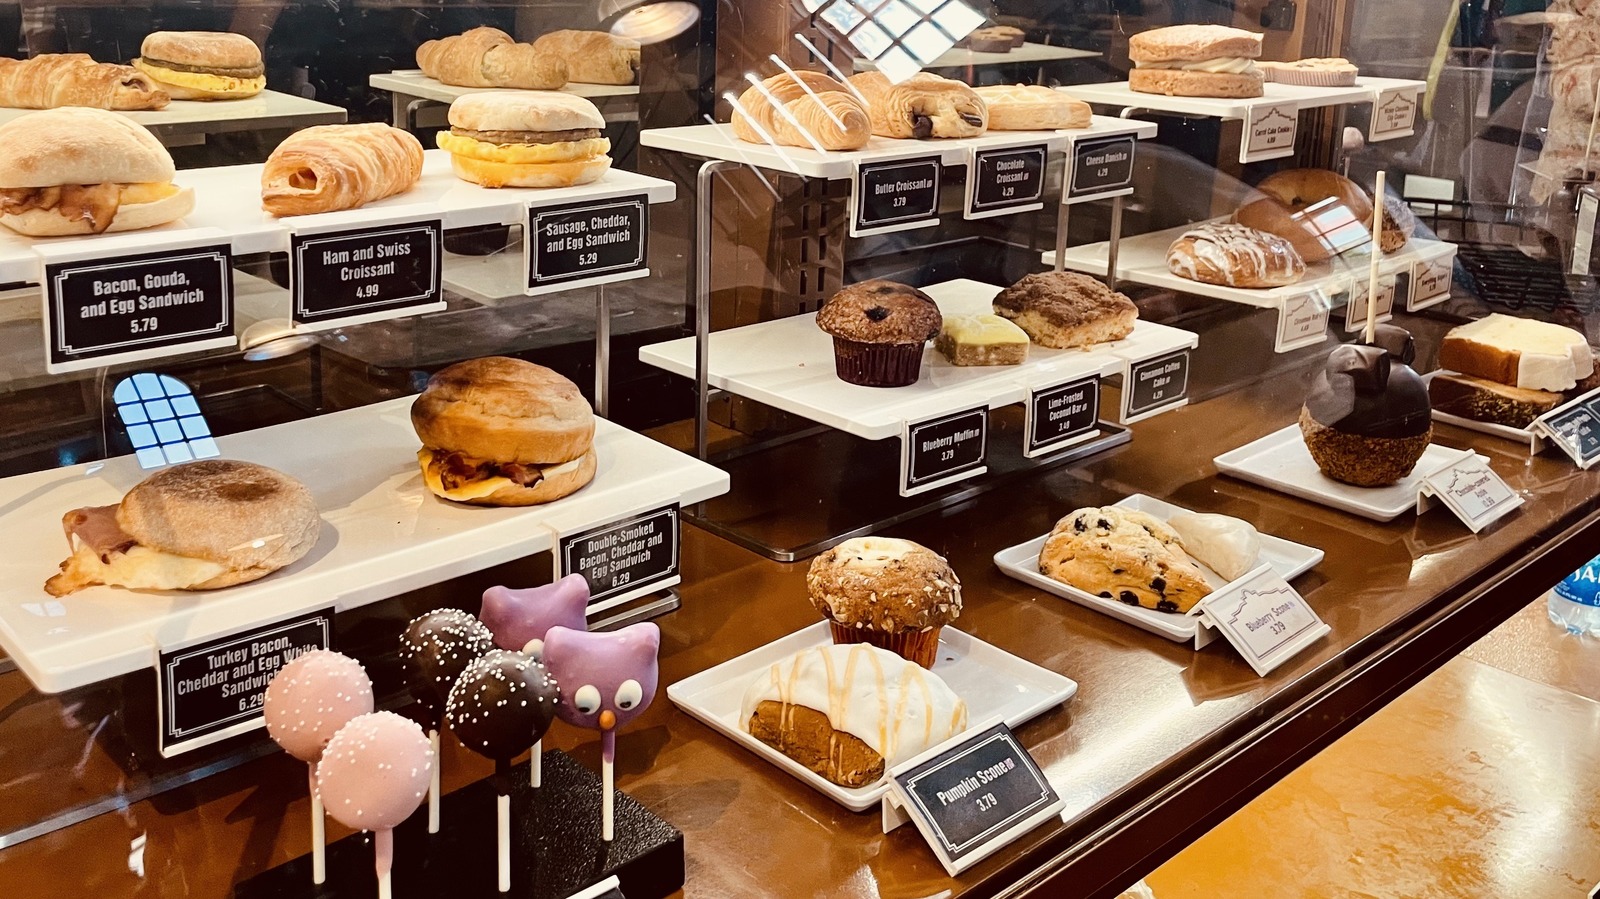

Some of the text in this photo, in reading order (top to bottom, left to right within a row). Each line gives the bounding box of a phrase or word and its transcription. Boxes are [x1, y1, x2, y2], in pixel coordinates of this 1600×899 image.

[997, 159, 1025, 171] Chocolate
[1086, 152, 1122, 166] Cheese Danish
[875, 178, 926, 195] Butter Croissant
[997, 172, 1023, 184] Croissant
[893, 196, 906, 207] 3.79
[546, 214, 631, 236] Sausage, Cheddar,
[547, 229, 630, 253] and Egg Sandwich
[323, 242, 411, 265] Ham and Swiss
[579, 252, 598, 266] 5.29
[340, 261, 394, 281] Croissant
[93, 271, 190, 296] Bacon, Gouda,
[356, 284, 379, 298] 4.99
[80, 288, 204, 319] and Egg Sandwich
[130, 317, 158, 333] 5.79
[1049, 390, 1083, 409] Lime-Frosted
[1050, 404, 1082, 421] Coconut Bar
[923, 429, 974, 452] Blueberry Muffin
[941, 449, 954, 461] 3.79
[588, 521, 654, 553] Double-Smoked
[580, 532, 662, 570] Bacon, Cheddar and
[592, 550, 651, 579] Egg Sandwich
[612, 572, 630, 587] 6.29
[1246, 602, 1290, 632] Blueberry Scone
[1270, 621, 1286, 635] 3.79
[207, 636, 292, 670] Turkey Bacon,
[177, 670, 229, 696] Cheddar
[233, 660, 255, 679] and
[258, 655, 280, 671] Egg
[239, 692, 264, 711] 6.29
[936, 760, 1008, 806] Pumpkin Scone
[976, 792, 997, 812] 3.79
